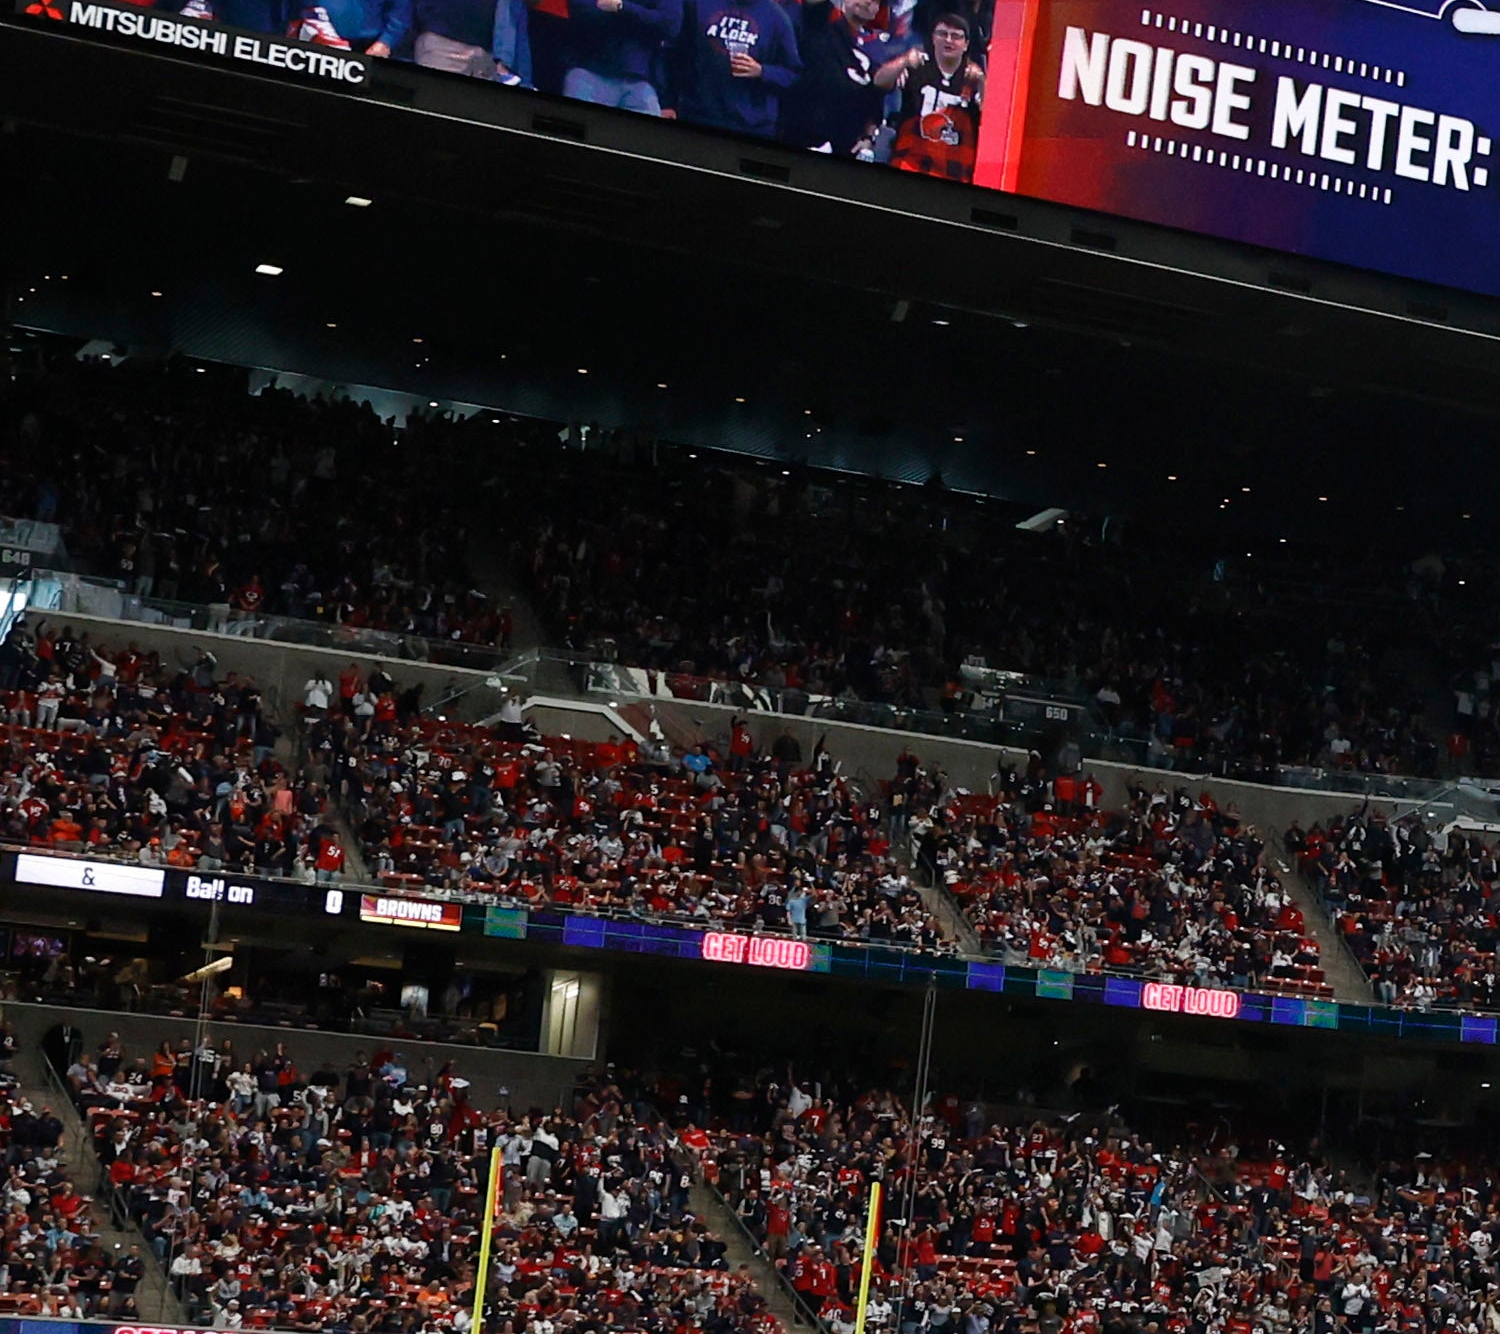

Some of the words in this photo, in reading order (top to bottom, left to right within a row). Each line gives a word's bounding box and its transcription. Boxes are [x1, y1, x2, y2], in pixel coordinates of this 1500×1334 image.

[720, 16, 748, 30] IT'S
[69, 0, 228, 55] MITSUBISHI
[233, 36, 366, 84] ELECTRIC
[707, 26, 717, 37] A
[720, 28, 758, 45] LOCK
[1058, 26, 1257, 141] NOISE
[1272, 76, 1491, 190] METER:
[1045, 706, 1067, 720] 650
[81, 868, 95, 887] &
[227, 885, 253, 903] on
[325, 890, 343, 913] 0
[375, 897, 442, 920] BROWNS
[703, 933, 747, 962] GET
[749, 938, 808, 969] LOUD
[1144, 983, 1183, 1011] GET
[1184, 987, 1237, 1017] LOUD
[931, 1139, 945, 1149] 99
